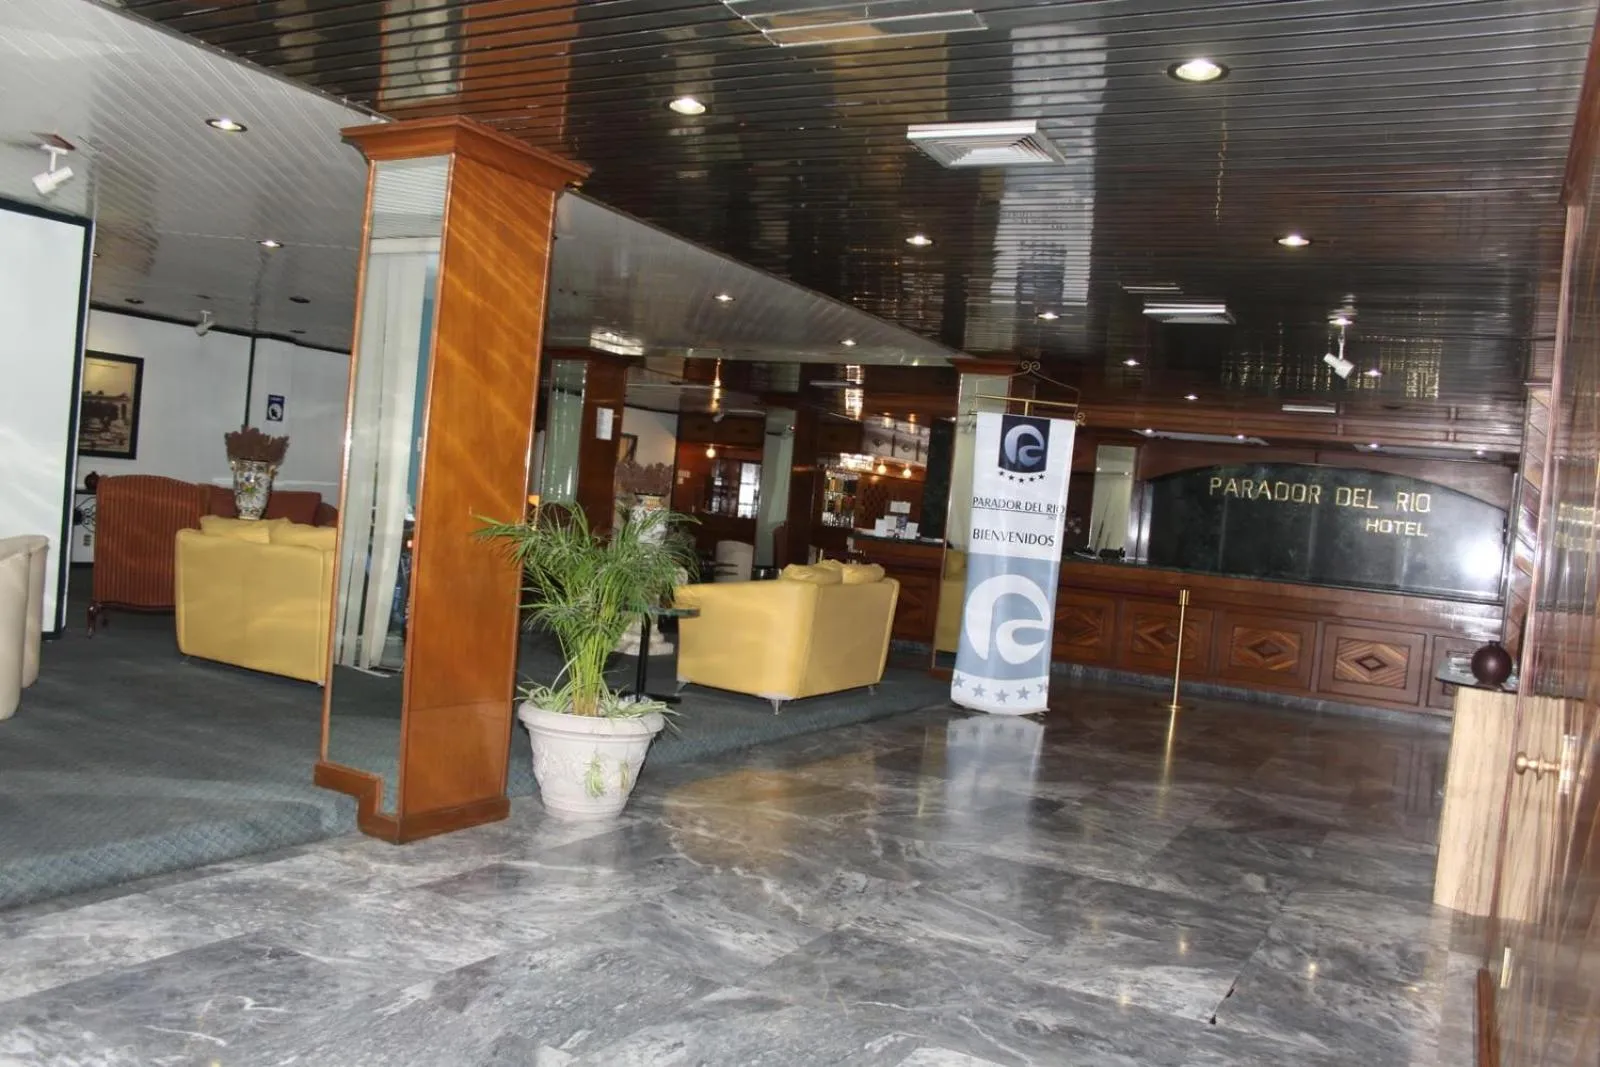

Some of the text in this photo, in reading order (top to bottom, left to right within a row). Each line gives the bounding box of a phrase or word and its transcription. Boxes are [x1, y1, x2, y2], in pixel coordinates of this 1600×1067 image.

[1209, 477, 1431, 513] PARADOR DEL RIO
[972, 496, 1065, 514] PARADOR DEL RIO
[1365, 517, 1428, 537] HOTEL
[972, 528, 1055, 547] BIENVENIDOS
